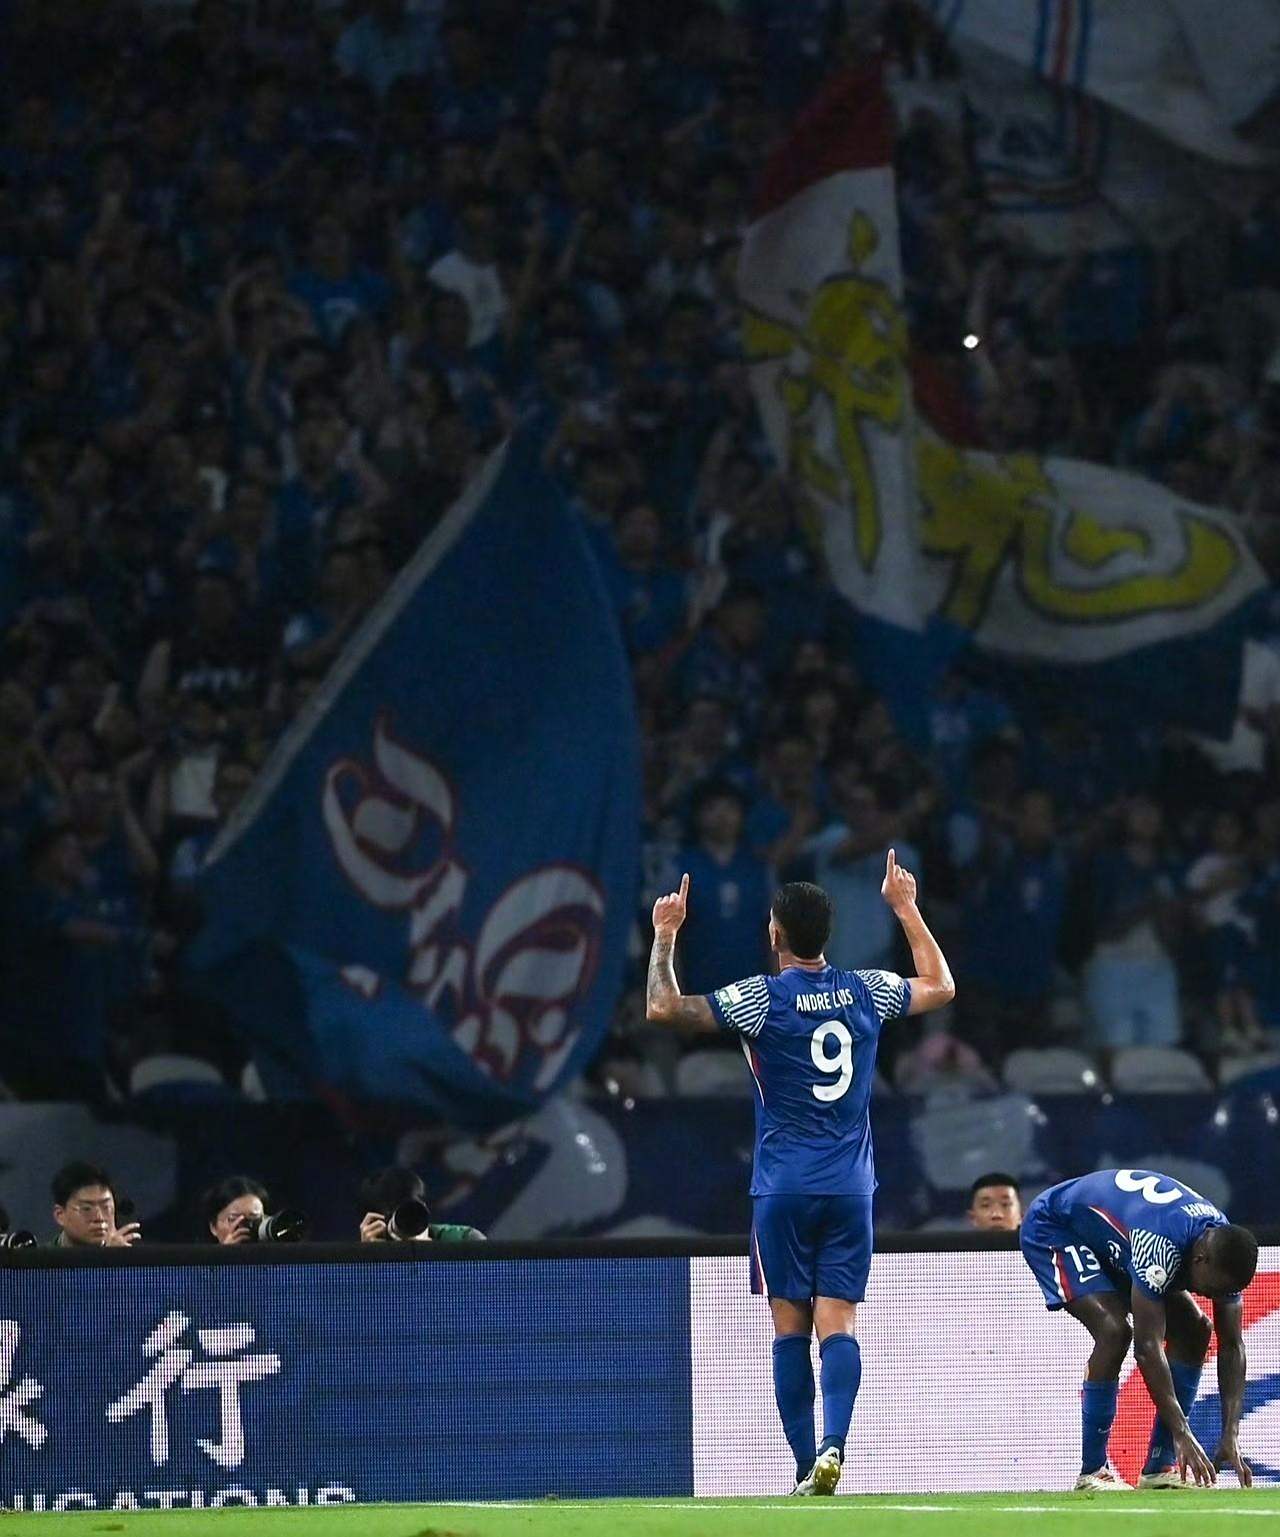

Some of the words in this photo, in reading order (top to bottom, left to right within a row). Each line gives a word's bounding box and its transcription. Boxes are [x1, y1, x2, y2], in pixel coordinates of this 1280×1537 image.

[796, 992, 832, 1012] ANDRE
[810, 1020, 854, 1102] 9
[1114, 1168, 1204, 1204] 3
[1064, 1245, 1101, 1274] 13
[0, 1310, 282, 1470] 行
